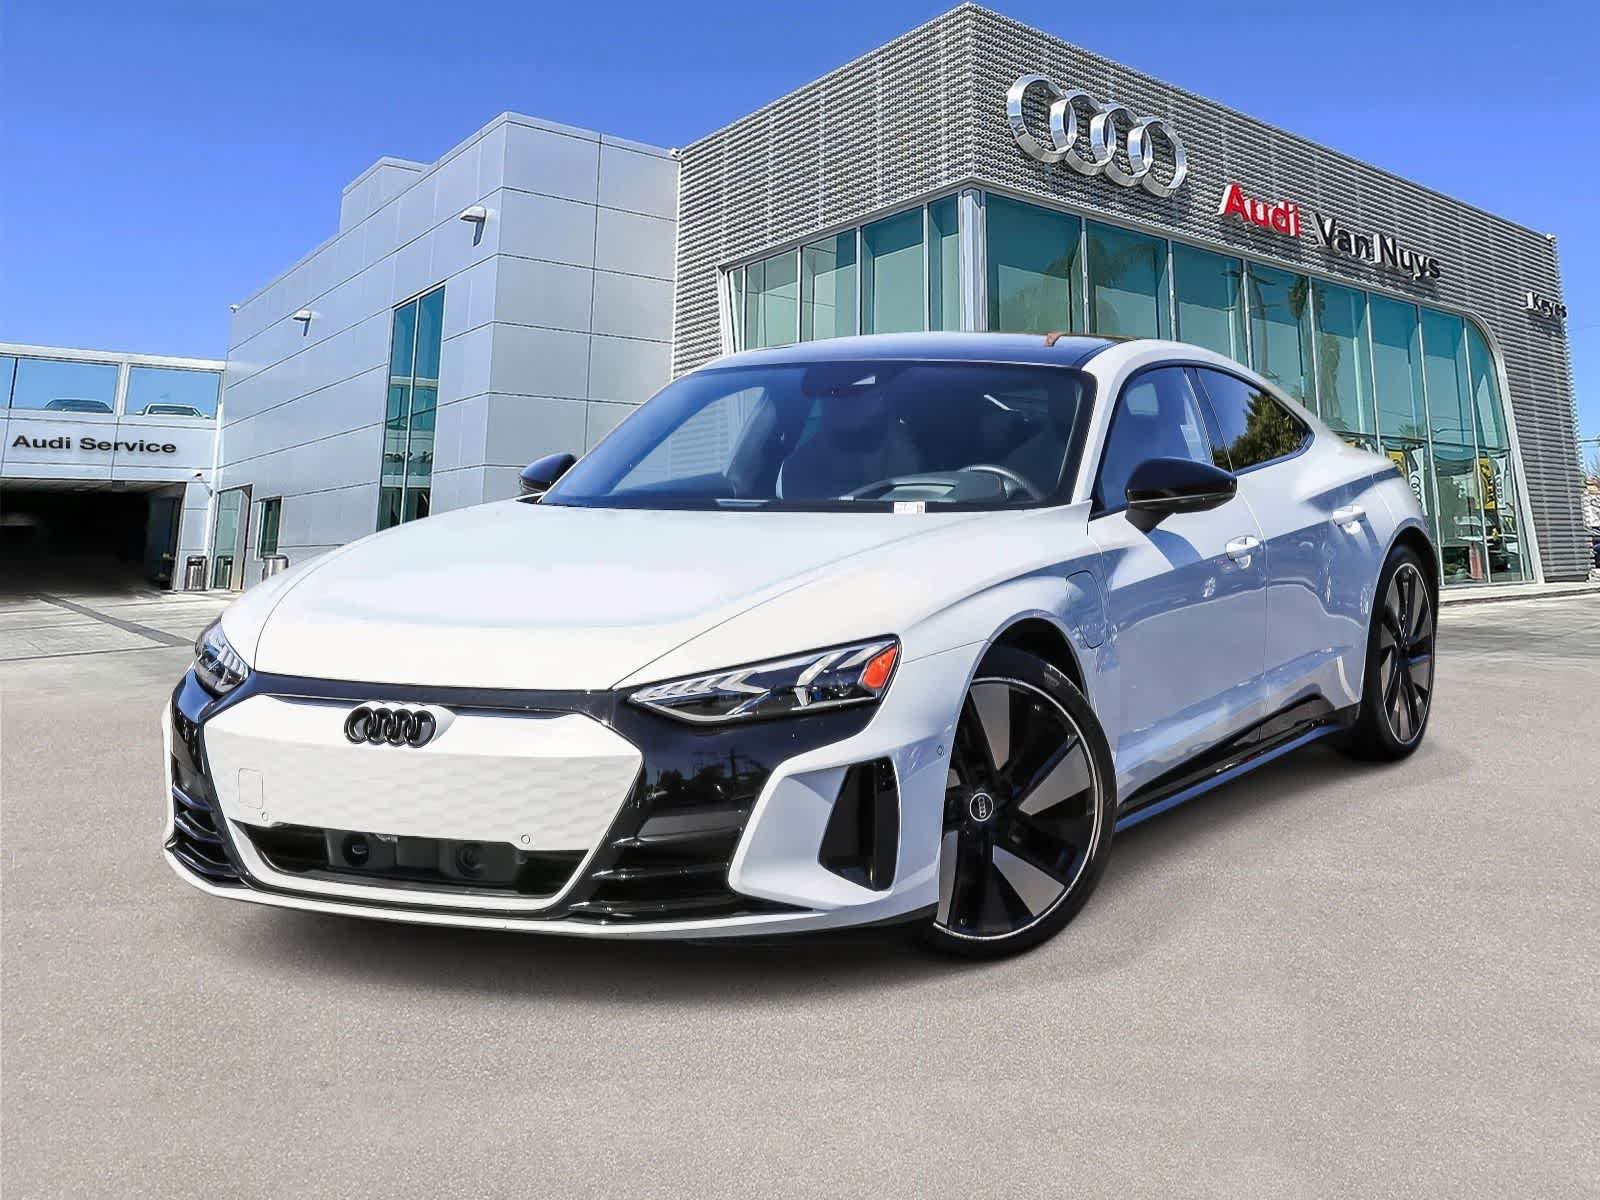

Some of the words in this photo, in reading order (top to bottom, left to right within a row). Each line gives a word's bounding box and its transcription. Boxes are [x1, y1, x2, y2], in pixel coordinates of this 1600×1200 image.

[1218, 183, 1301, 237] Audi
[1311, 211, 1371, 259] Van
[1373, 233, 1441, 280] Nuys
[12, 434, 71, 450] Audi
[79, 437, 177, 454] Service
